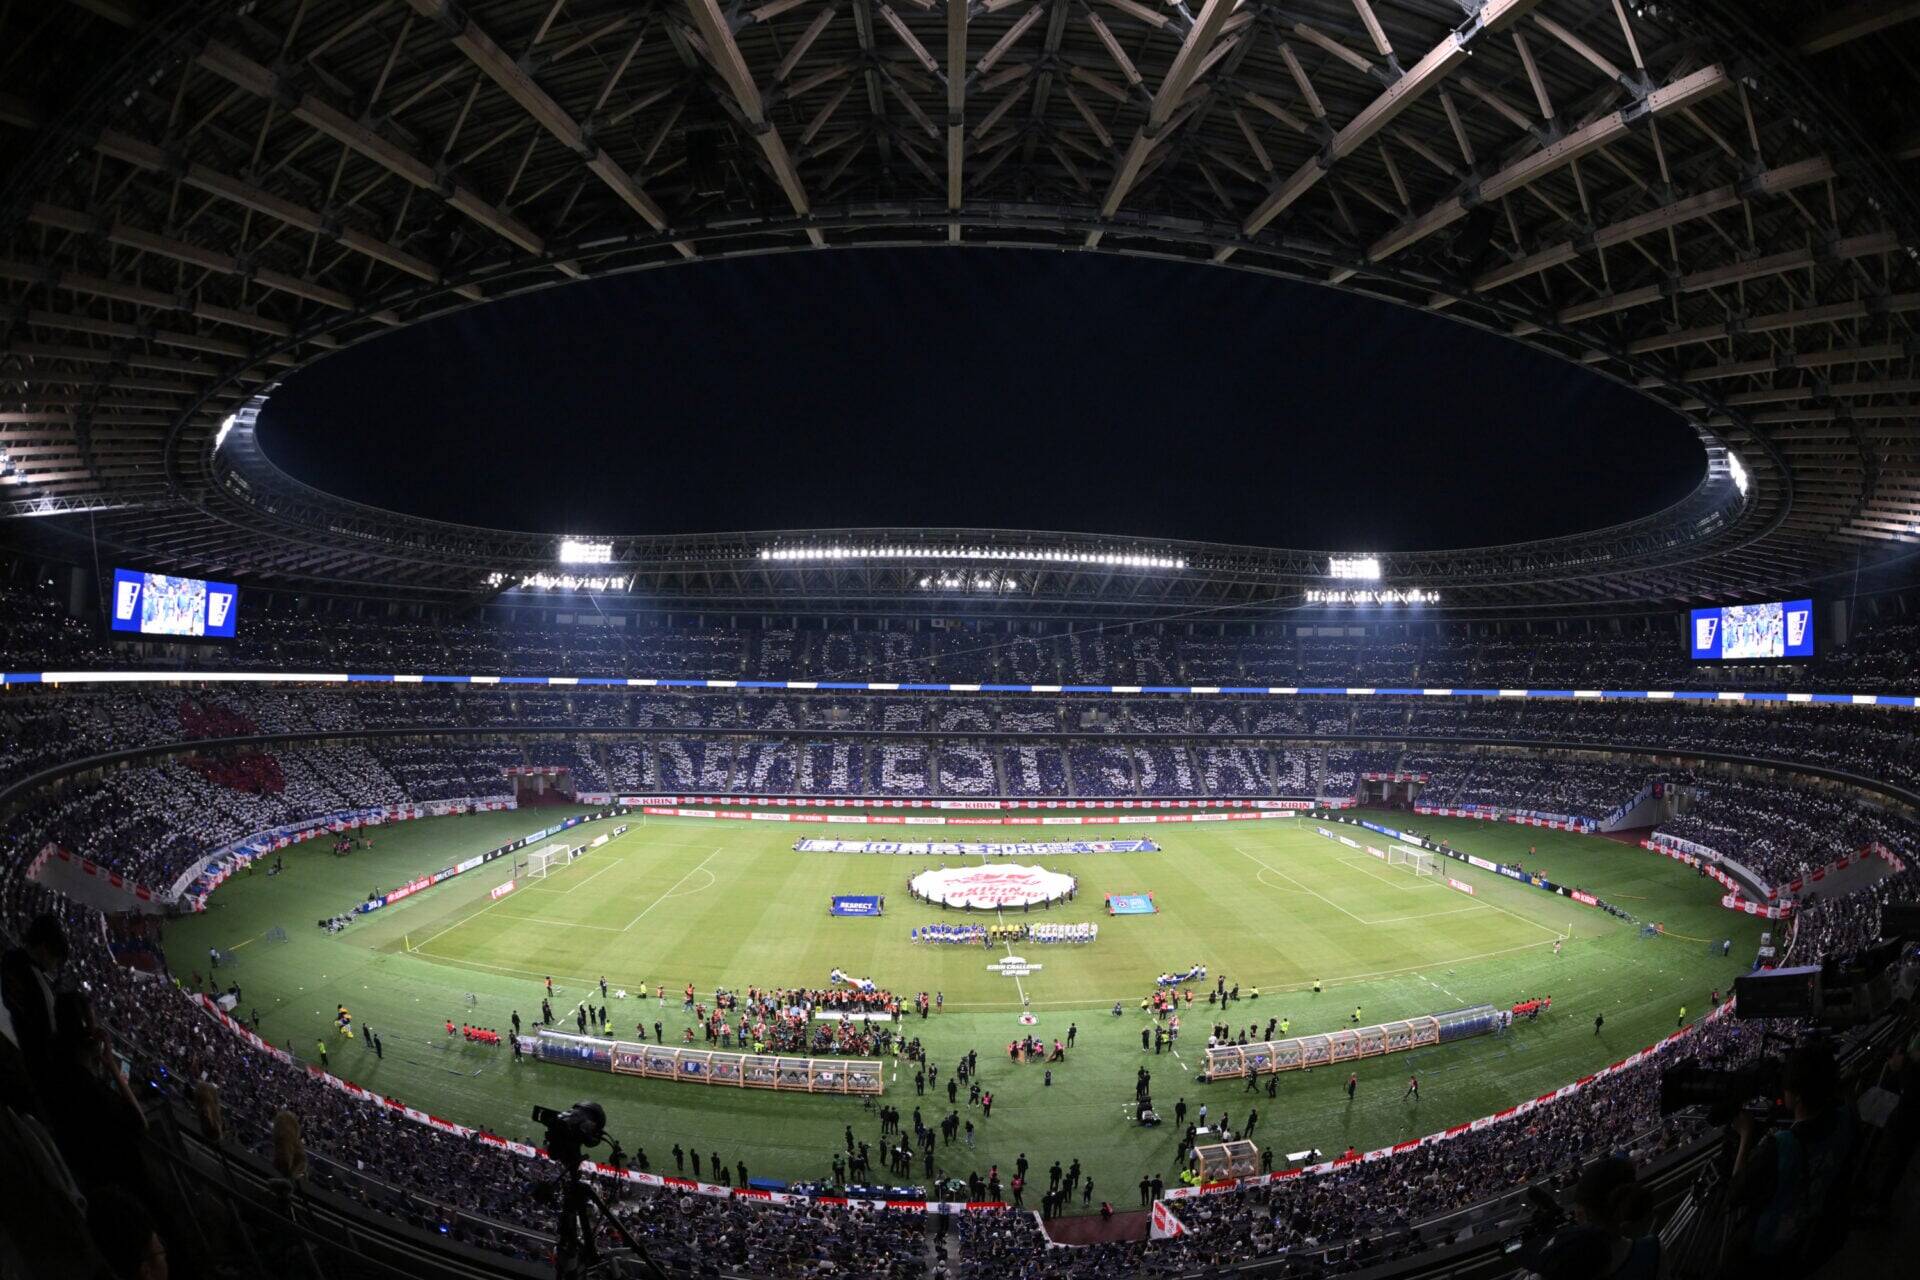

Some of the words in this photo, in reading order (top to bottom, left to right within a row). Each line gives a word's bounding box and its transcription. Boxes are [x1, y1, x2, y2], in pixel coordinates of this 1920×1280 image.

[759, 631, 917, 679] FOR
[1010, 634, 1172, 684] OUR
[1280, 801, 1311, 809] KIRIN
[1580, 893, 1597, 906] KIRIN
